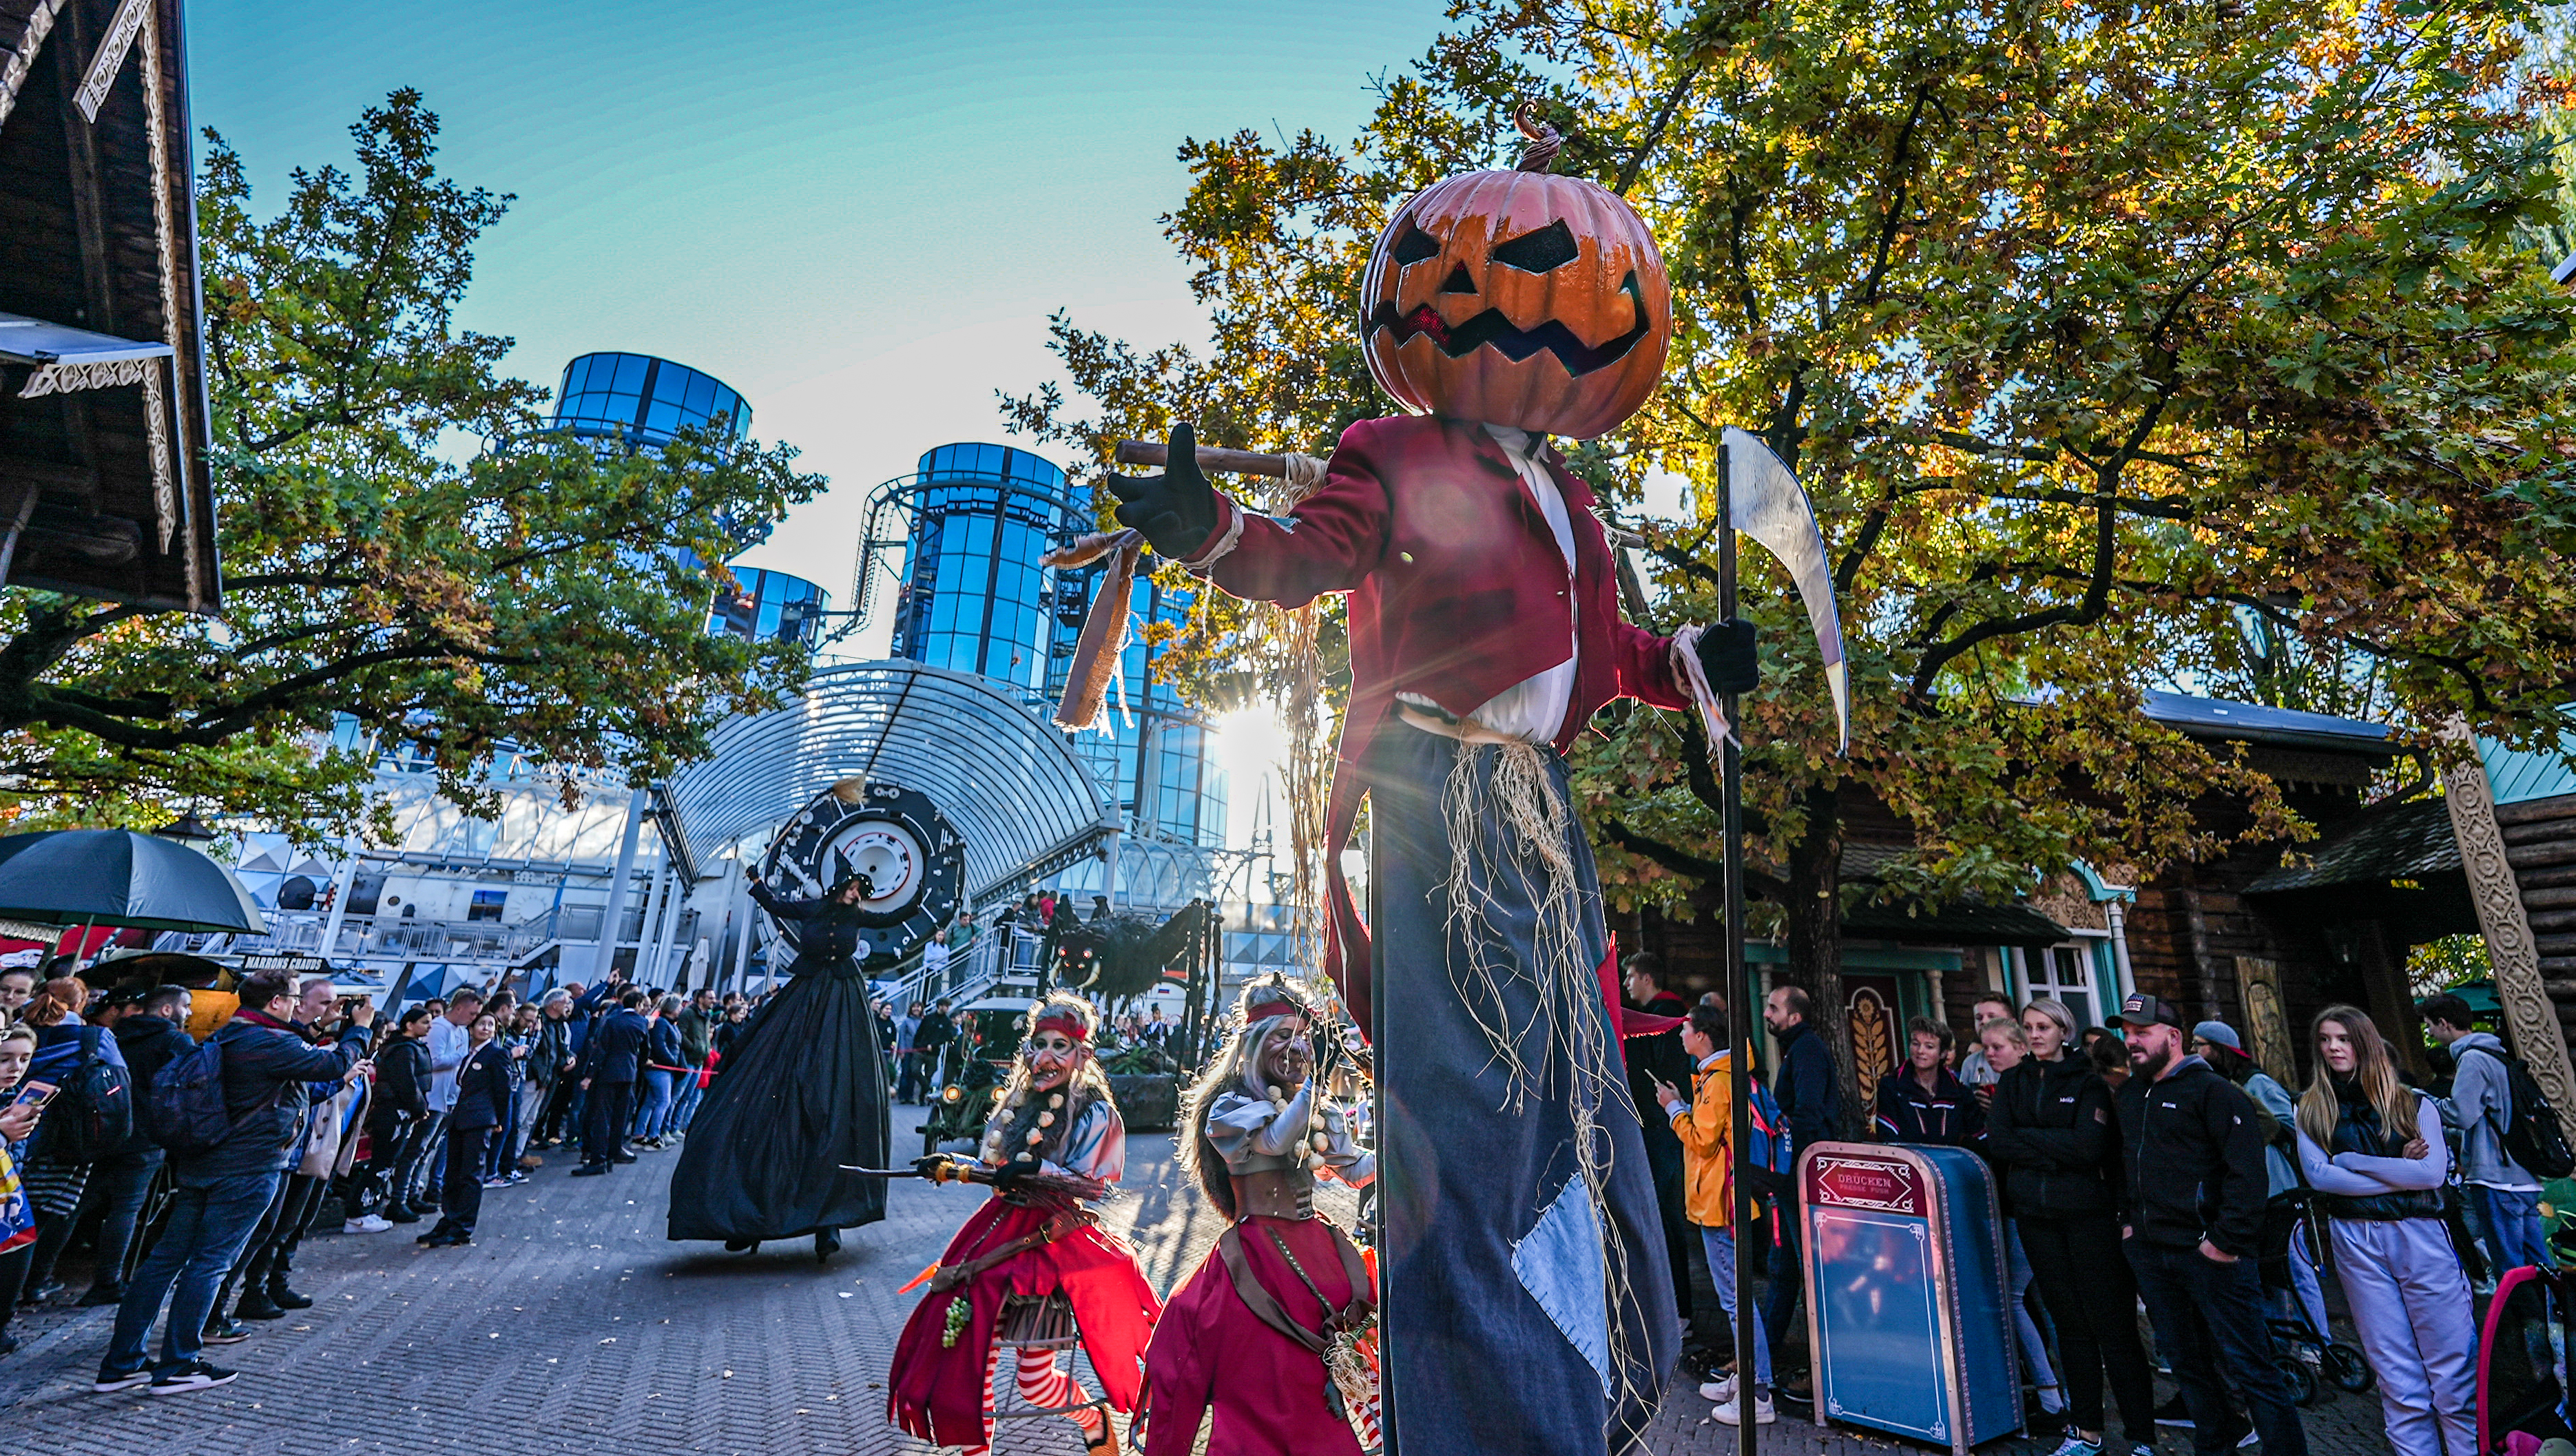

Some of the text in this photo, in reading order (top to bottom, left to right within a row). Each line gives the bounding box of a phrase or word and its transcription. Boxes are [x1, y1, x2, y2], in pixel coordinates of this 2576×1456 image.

[245, 956, 322, 970] MARRONS CHAUDS
[1838, 1172, 1891, 1187] DRÜCKEN
